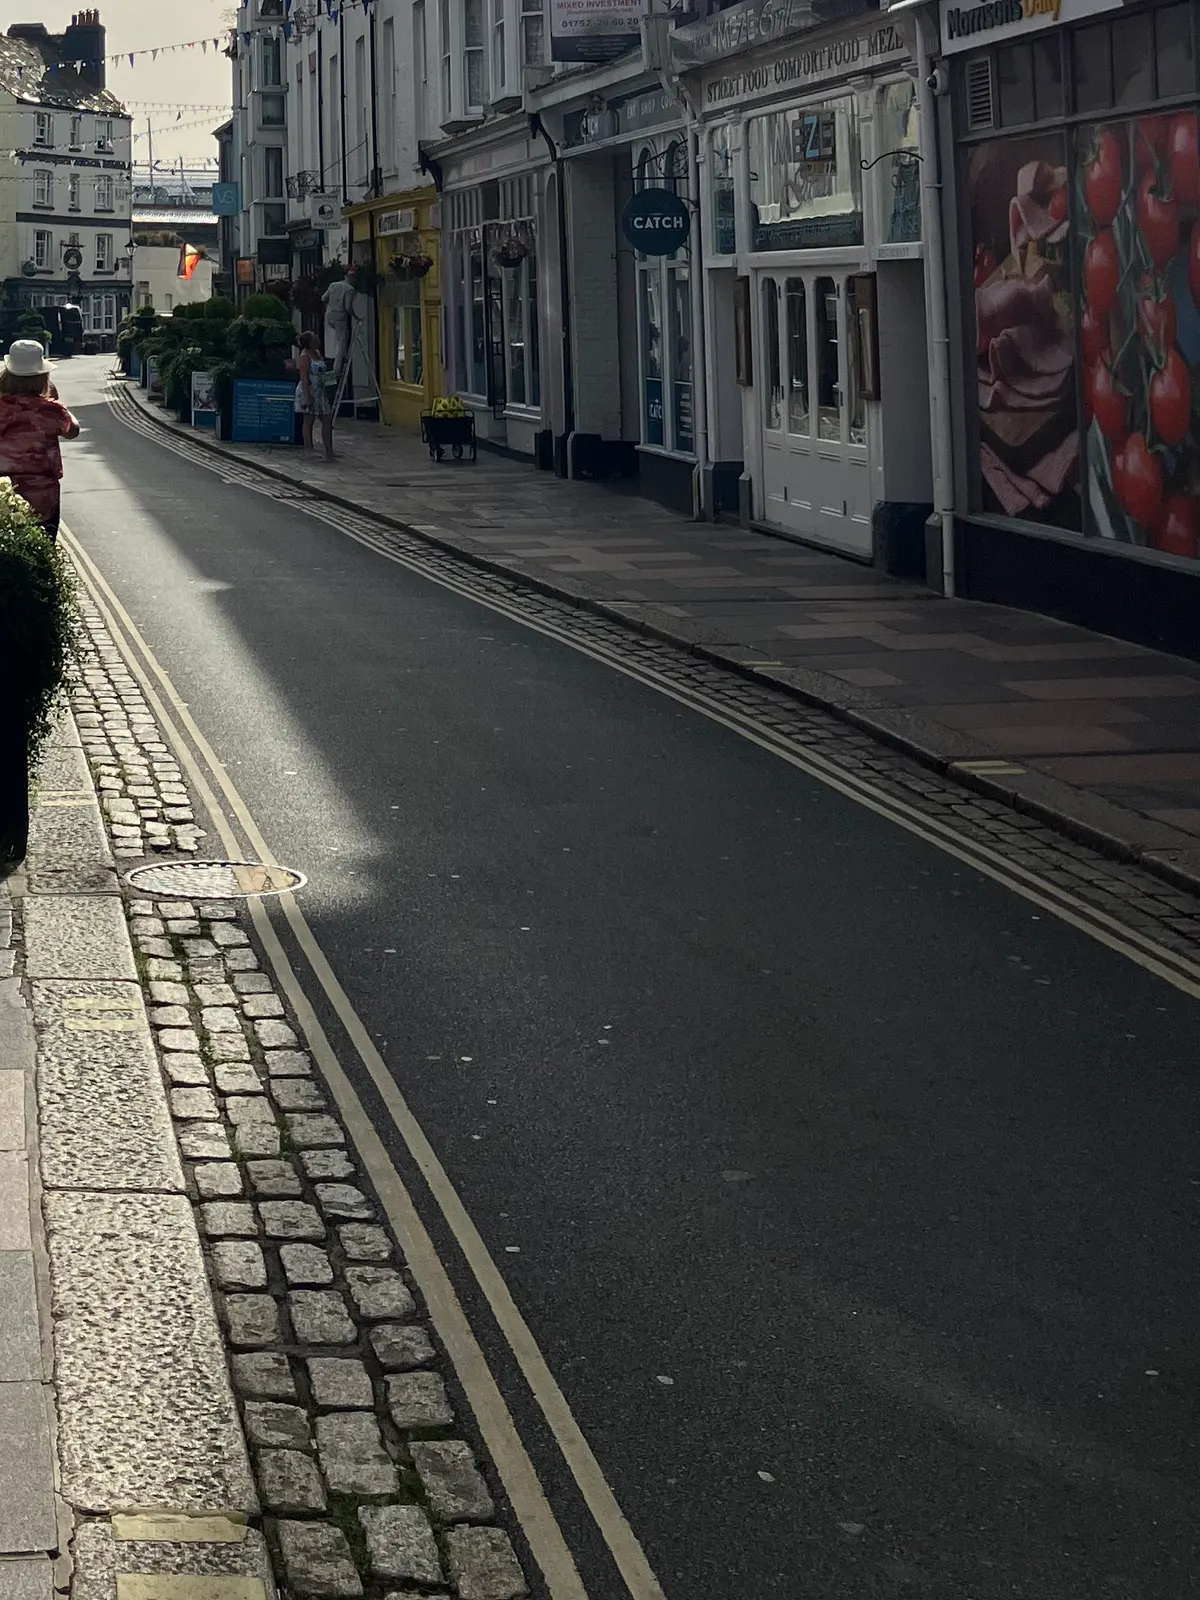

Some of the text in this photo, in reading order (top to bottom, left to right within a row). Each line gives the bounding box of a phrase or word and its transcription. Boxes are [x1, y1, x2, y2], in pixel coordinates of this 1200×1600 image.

[557, 0, 642, 10] MIXED INVESTMENT
[562, 19, 591, 28] 01752
[596, 18, 608, 26] 20
[627, 17, 639, 26] 20
[713, 9, 755, 51] MEZE
[707, 26, 904, 103] STREET FOOD COMFORT FOOD MEZE
[633, 216, 683, 229] CATCH
